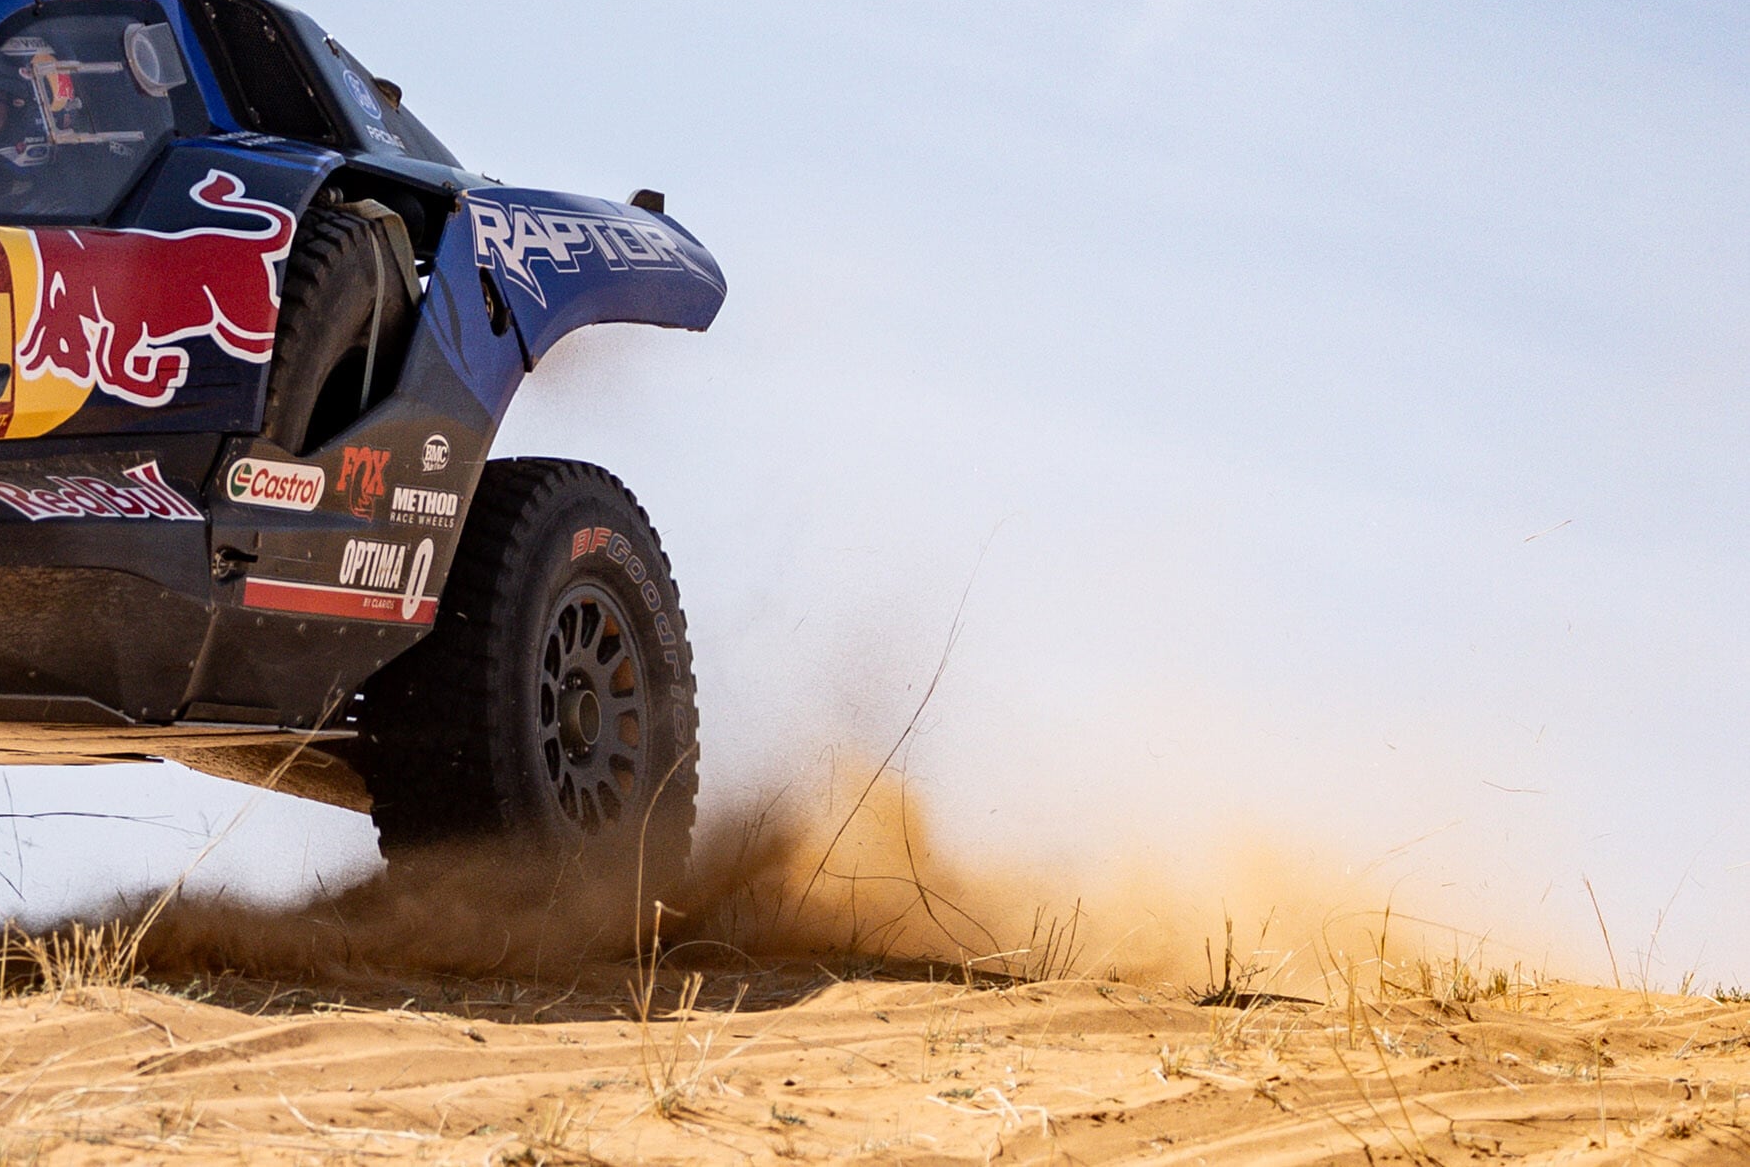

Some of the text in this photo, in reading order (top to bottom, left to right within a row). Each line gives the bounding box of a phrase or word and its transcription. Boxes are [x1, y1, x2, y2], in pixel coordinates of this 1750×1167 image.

[467, 198, 715, 302] RAPTOR
[335, 446, 391, 504] FOX
[424, 444, 448, 464] BMC
[66, 460, 205, 522] Bull
[251, 467, 322, 505] Castrol
[392, 487, 458, 516] METHOD
[390, 512, 455, 529] RACE WHEELS
[340, 538, 406, 590] OPTIMA
